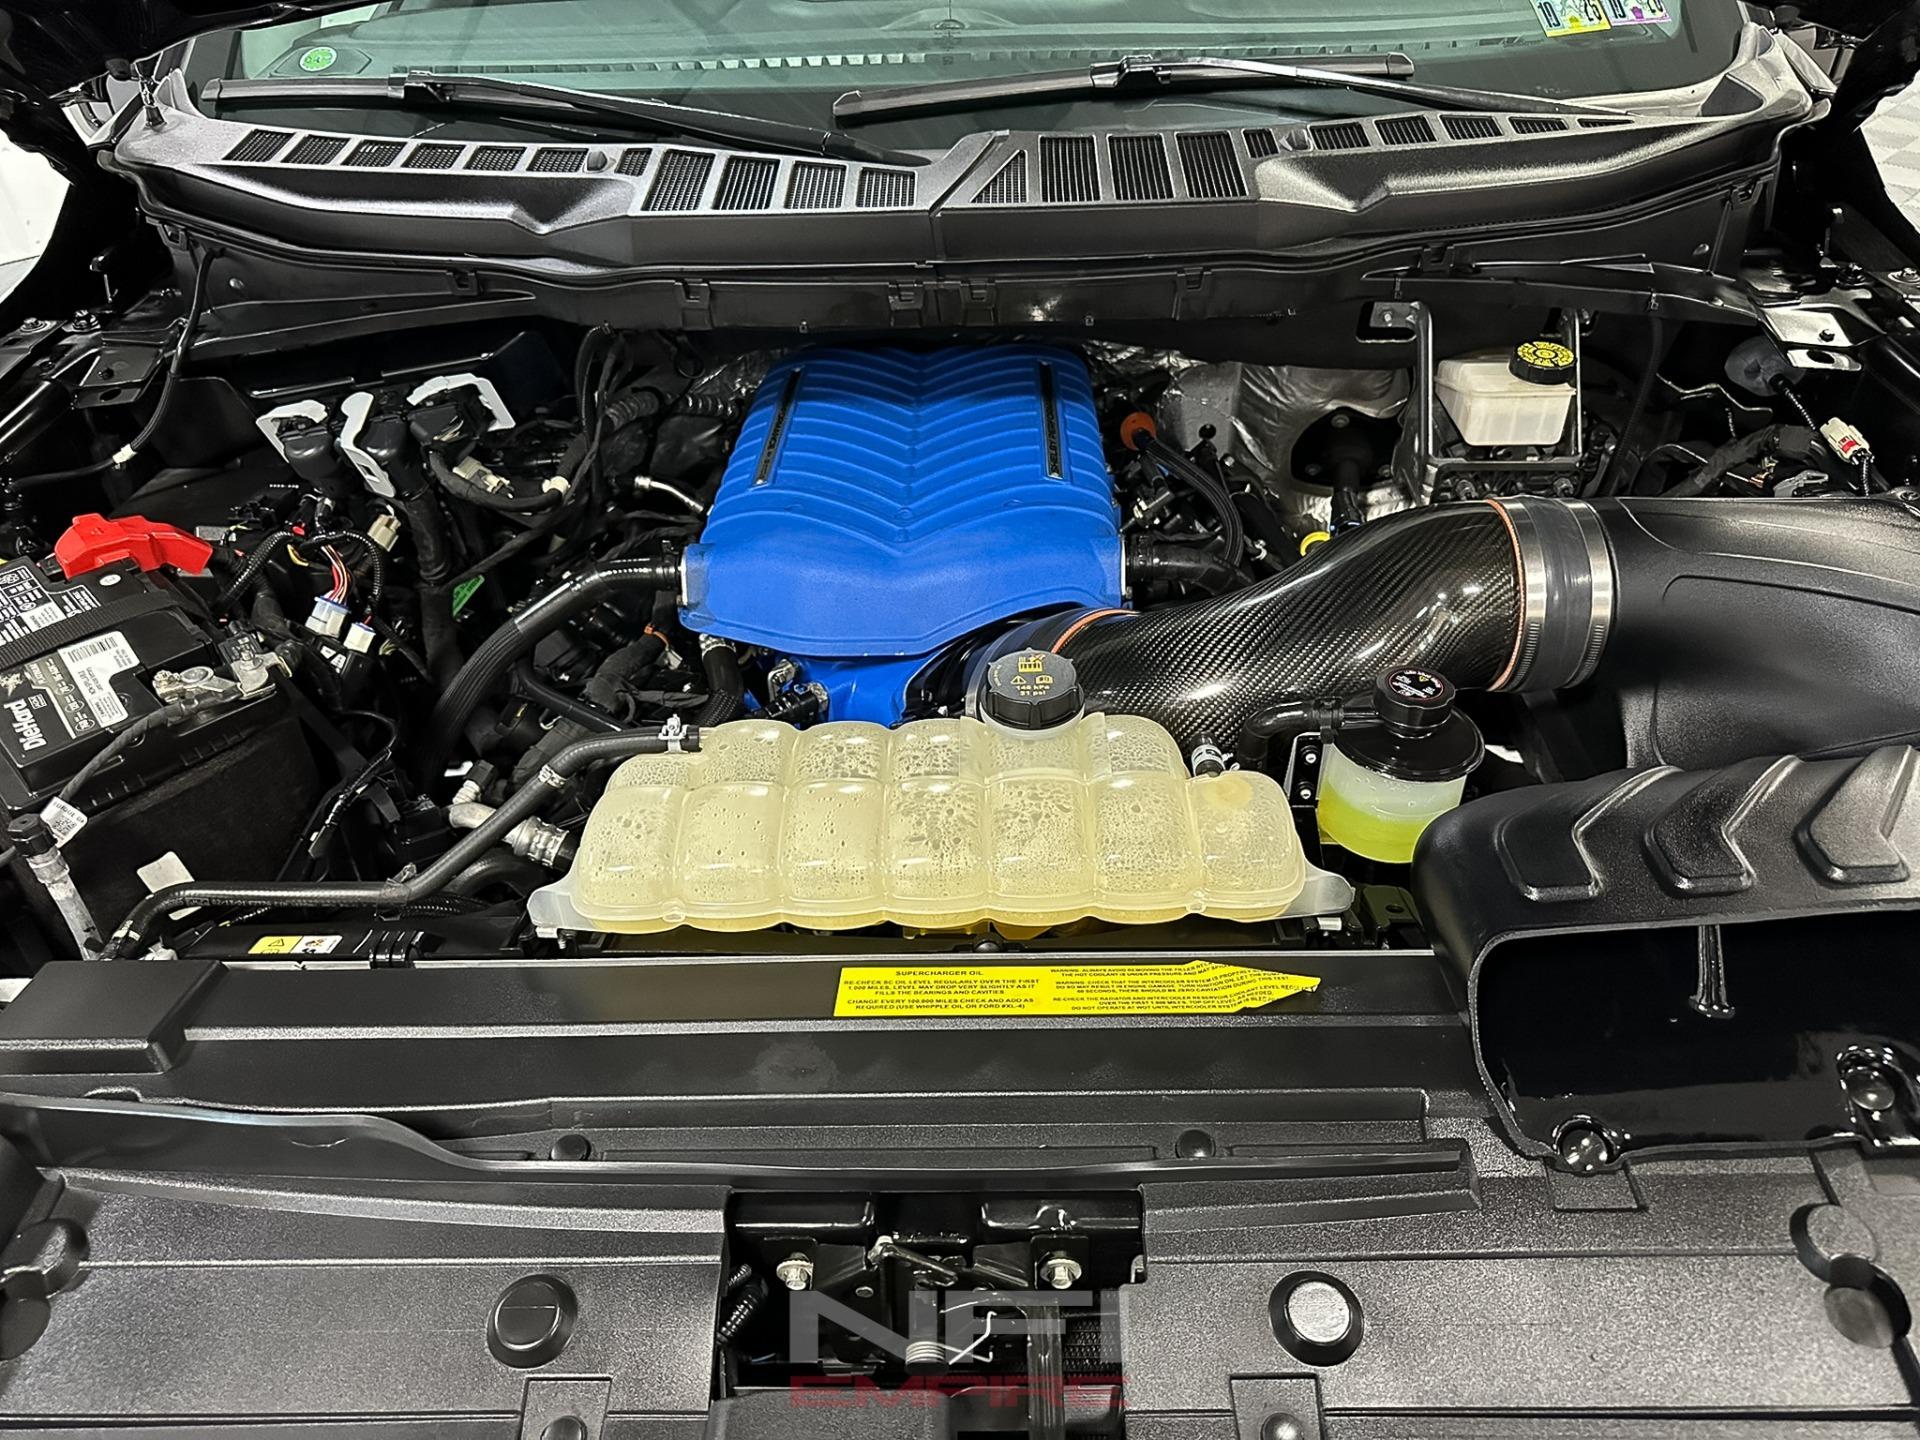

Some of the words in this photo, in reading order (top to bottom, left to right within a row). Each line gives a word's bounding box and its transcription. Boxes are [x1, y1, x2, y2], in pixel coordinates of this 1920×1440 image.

[1537, 1, 1561, 28] 10
[4, 698, 47, 751] DieHard
[1220, 970, 1251, 979] PROPERLY
[1229, 987, 1258, 997] COOLANT
[1218, 1000, 1242, 1009] SYSTEM
